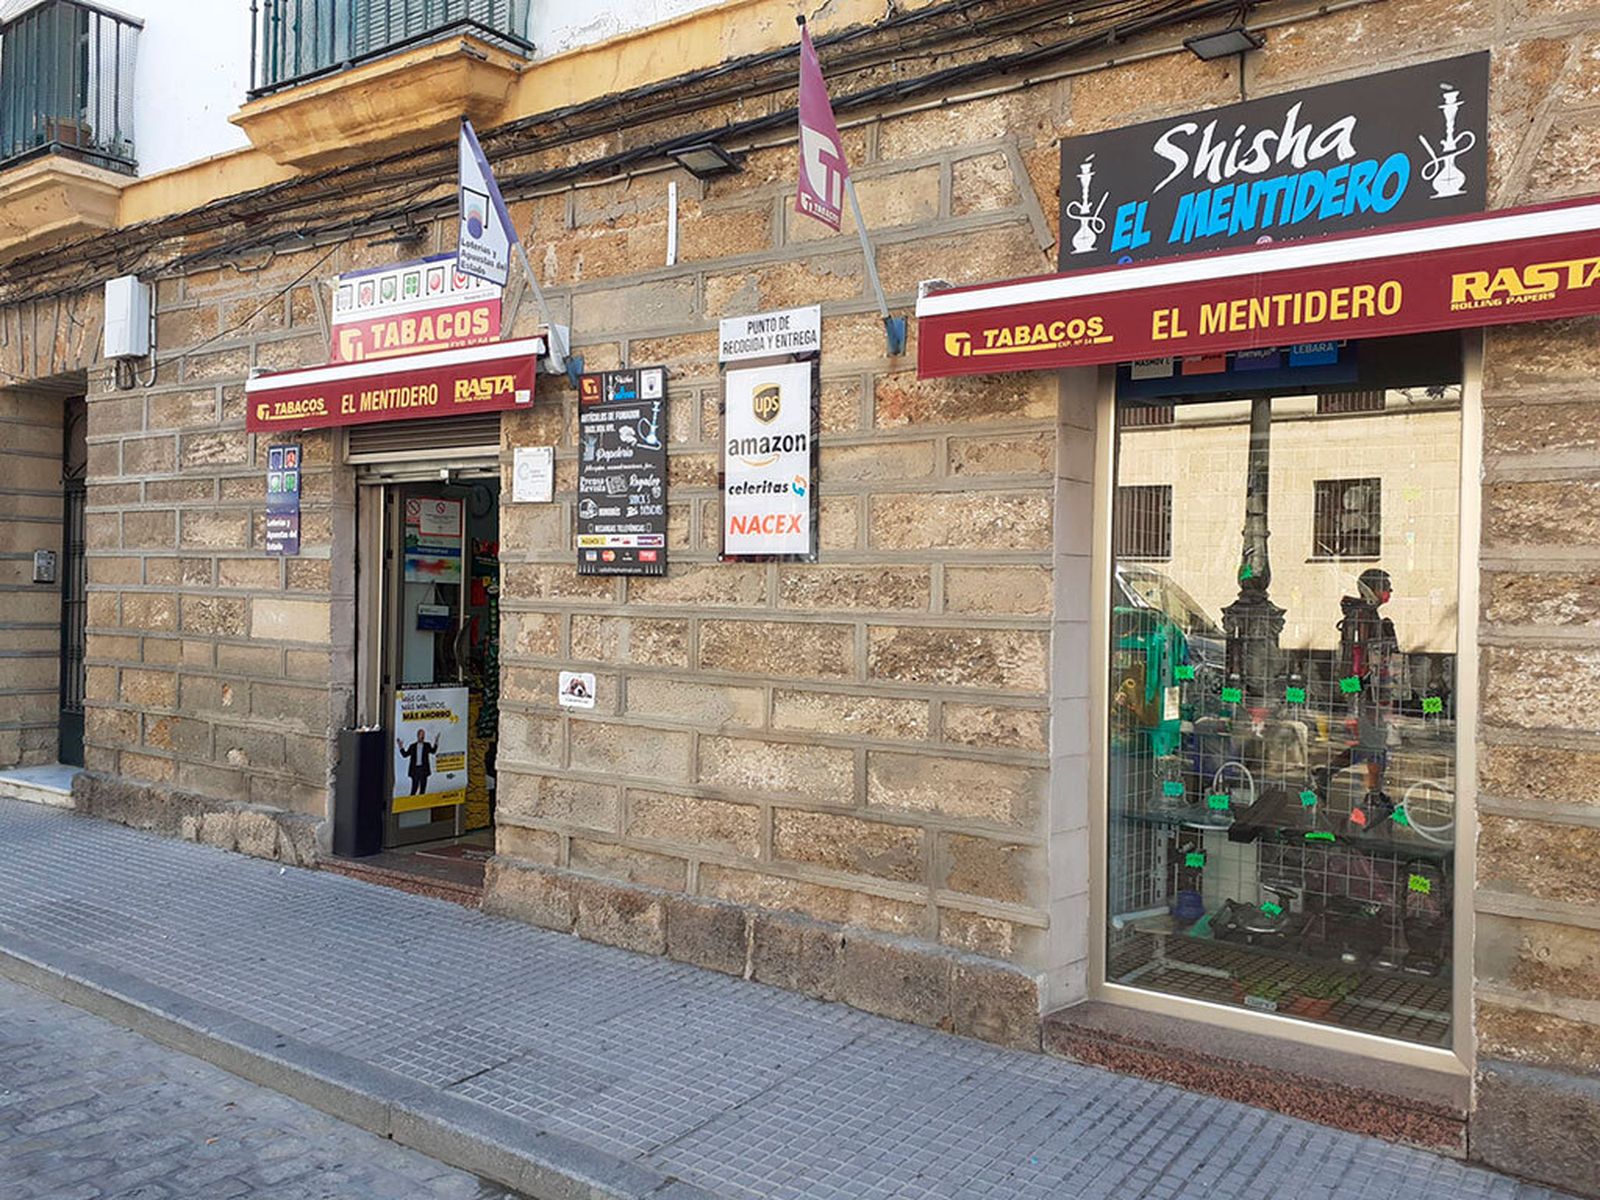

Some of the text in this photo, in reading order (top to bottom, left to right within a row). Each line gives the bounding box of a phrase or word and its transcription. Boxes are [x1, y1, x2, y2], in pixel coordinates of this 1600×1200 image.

[1152, 101, 1358, 194] Shisha
[1111, 152, 1411, 253] EL MENTIDERO
[1451, 292, 1556, 312] ROLLING PAPERS
[747, 315, 791, 335] PUNTO DE
[983, 316, 1104, 348] TABACOS
[1152, 307, 1188, 340] EL
[1200, 281, 1403, 335] MENTIDERO
[371, 307, 490, 350] TABACOS
[723, 330, 818, 355] RECOGIDA Y ENTREGA
[274, 375, 515, 415] TABACOS EL MENTIDERO RASTA
[754, 395, 780, 418] ups
[728, 433, 807, 456] amazon
[728, 480, 789, 496] celeritas
[729, 513, 802, 535] NACEX
